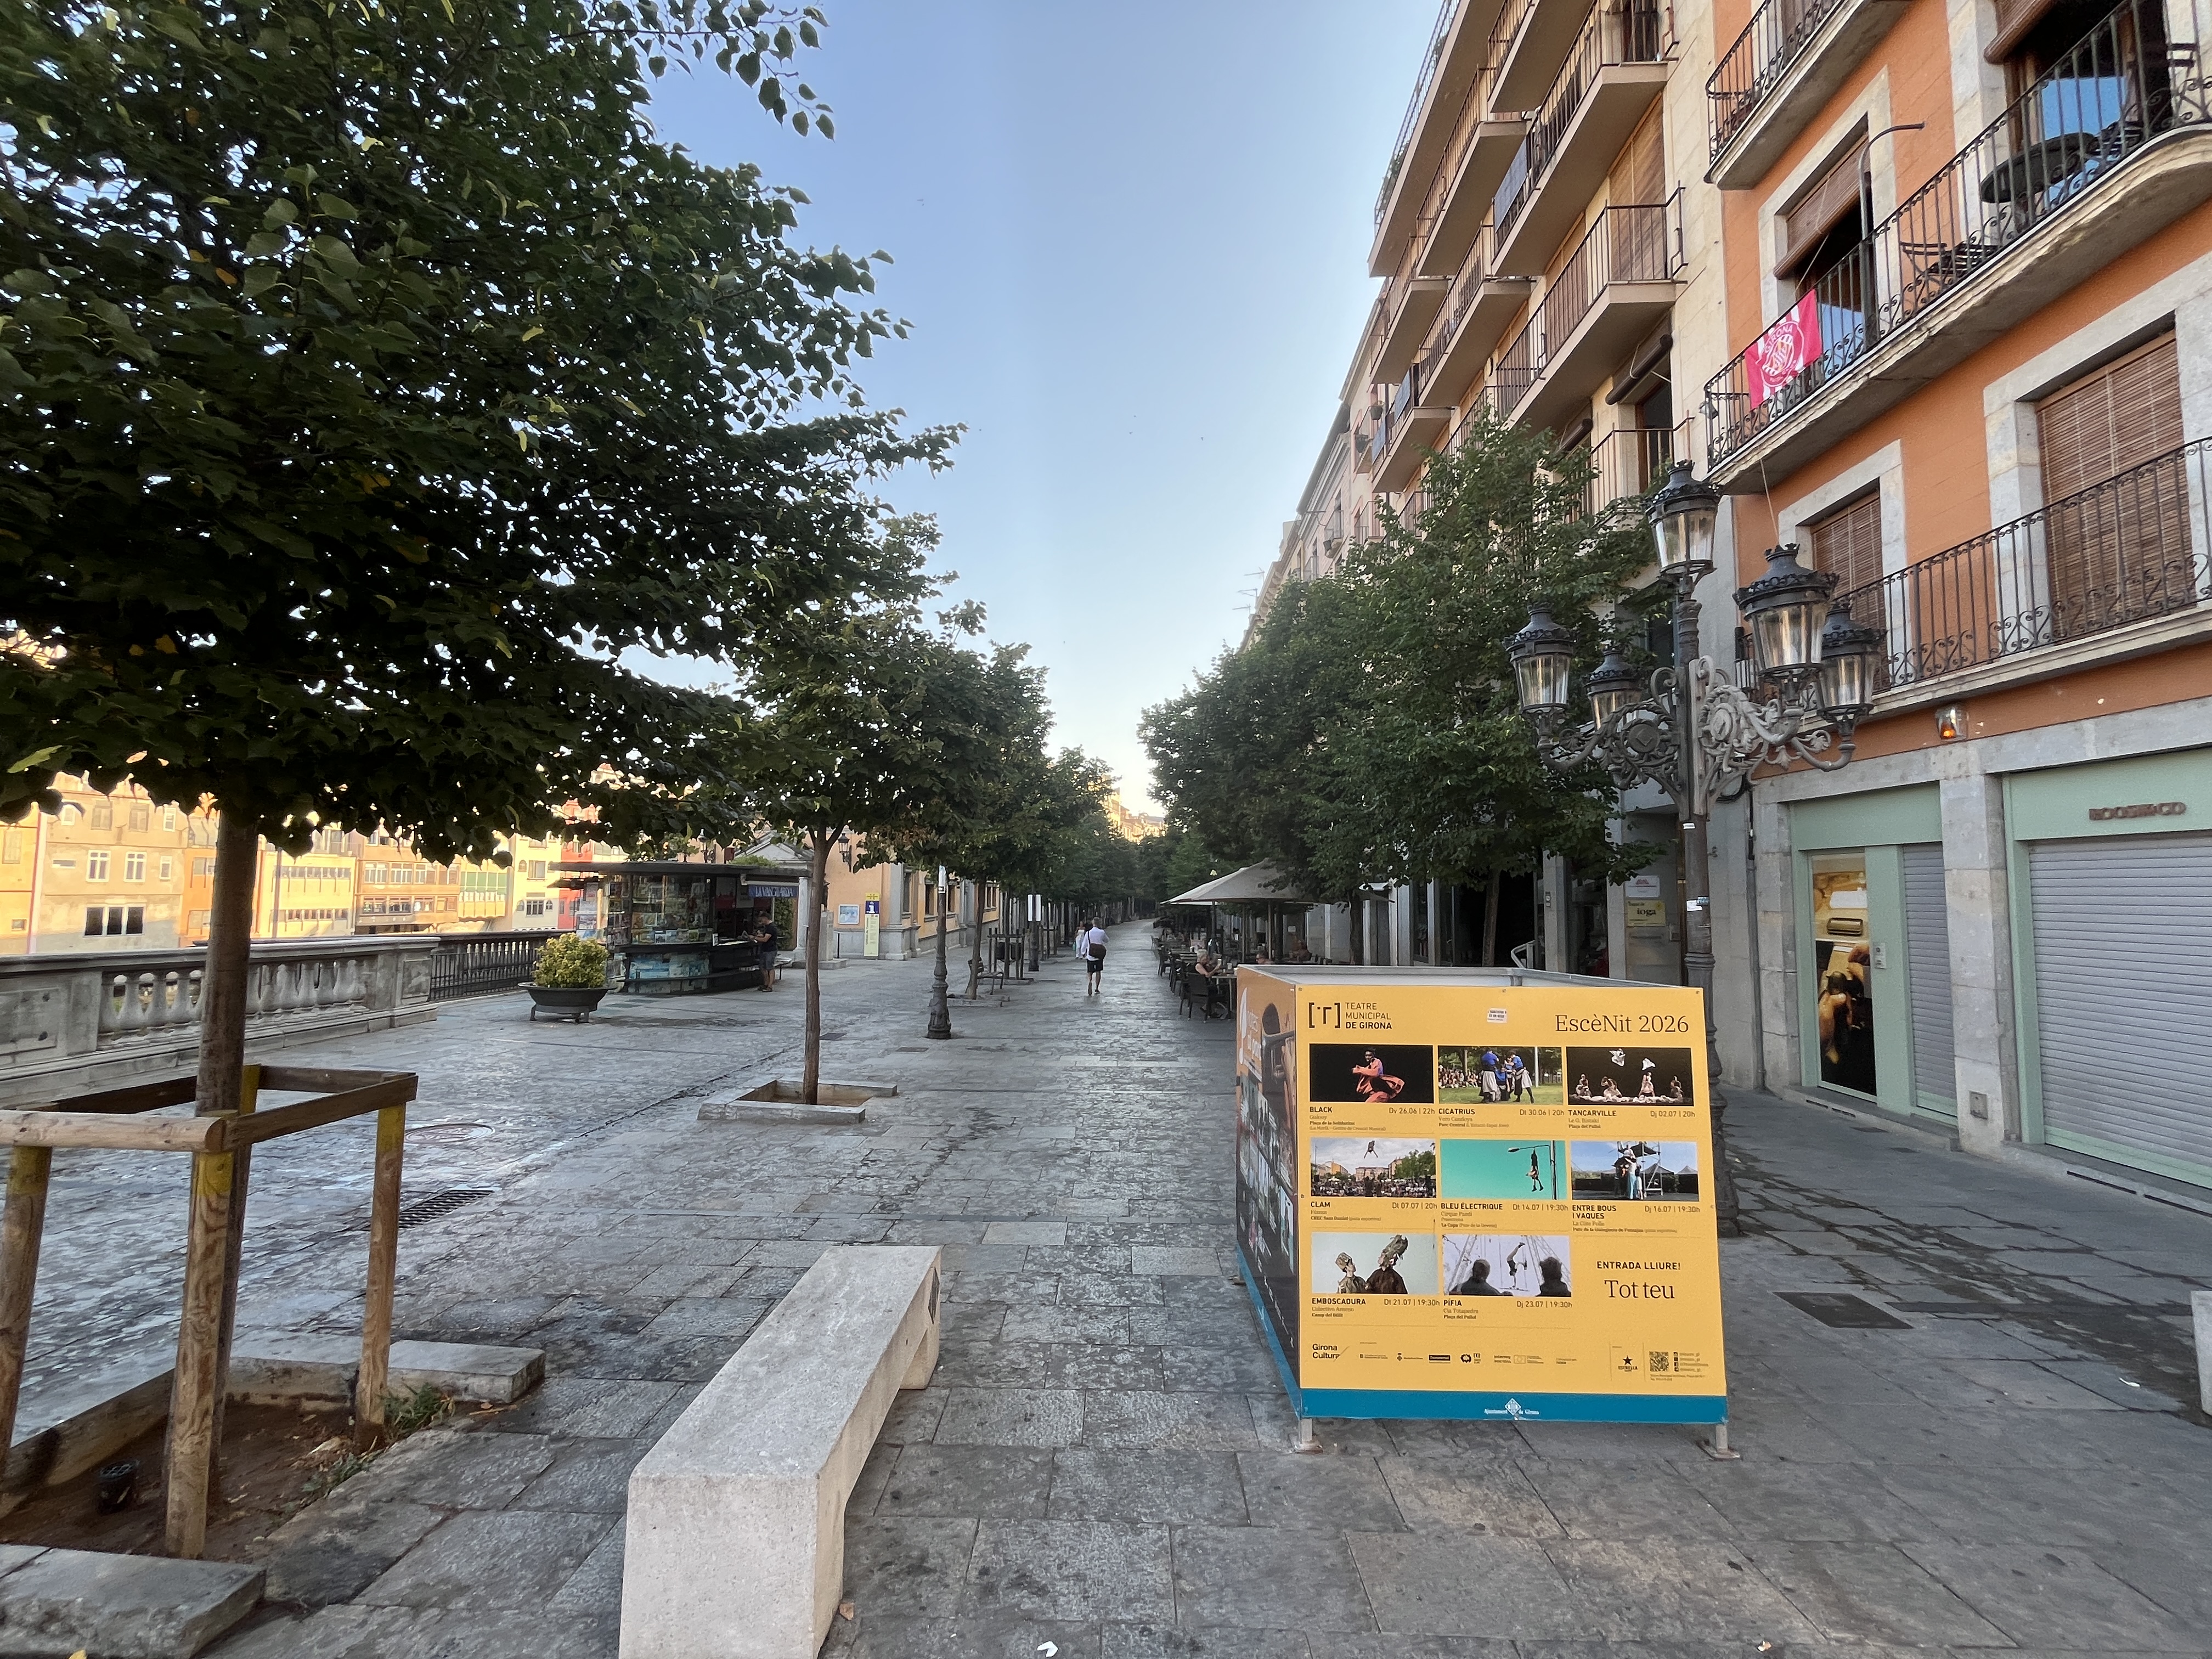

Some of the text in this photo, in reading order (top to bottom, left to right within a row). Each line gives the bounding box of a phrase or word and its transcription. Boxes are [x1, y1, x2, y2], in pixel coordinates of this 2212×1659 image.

[1765, 324, 1793, 353] GIRONA
[1637, 908, 1656, 917] ioga
[1555, 1014, 1689, 1032] EscèNit 2026
[1460, 1201, 1503, 1210] ÉLECTRIQUE
[1645, 1262, 1680, 1270] LLIURE!
[1604, 1280, 1675, 1299] Tot teu
